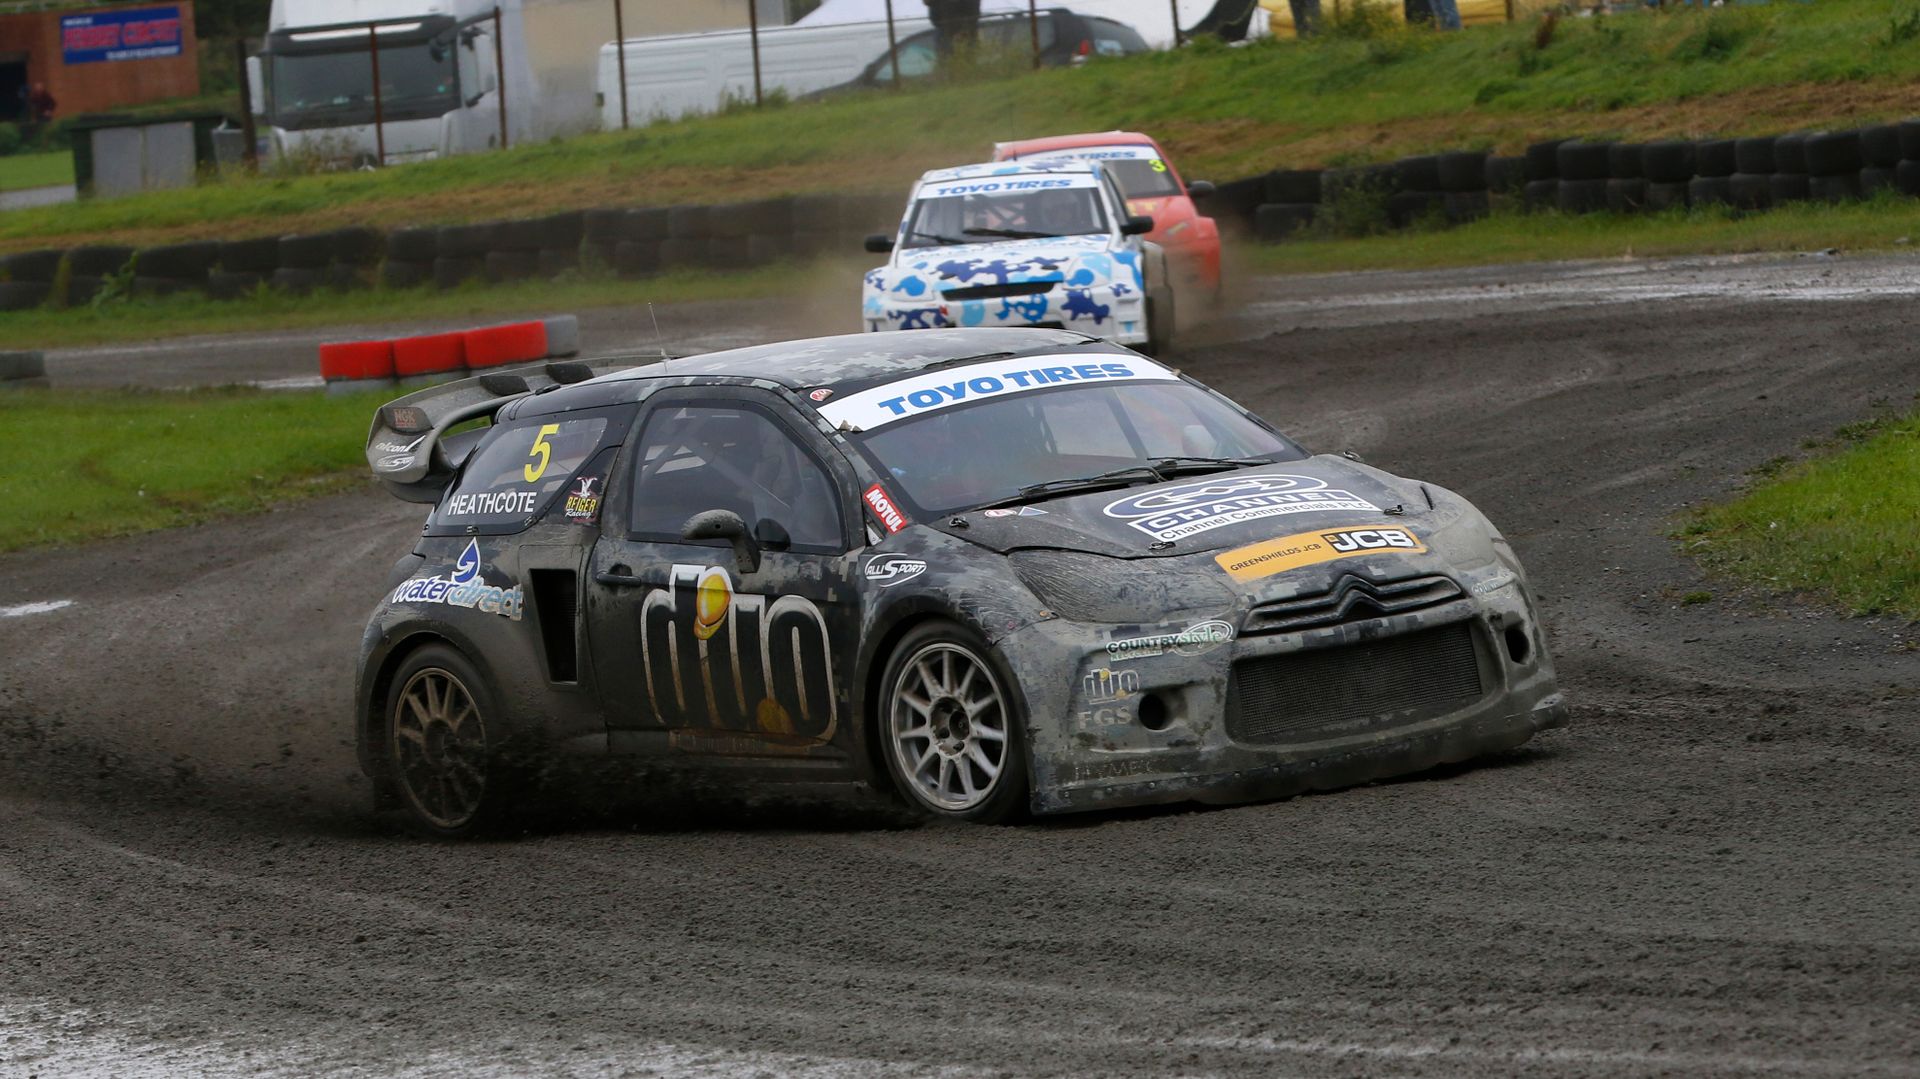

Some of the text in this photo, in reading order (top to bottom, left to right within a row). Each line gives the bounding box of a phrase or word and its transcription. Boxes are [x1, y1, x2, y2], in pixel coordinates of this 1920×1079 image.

[1149, 159, 1166, 173] 3
[937, 179, 1073, 195] TOYO TIRES
[878, 363, 1135, 415] TOYO TIRES
[524, 423, 560, 483] 5
[447, 491, 537, 515] HEATHCOTE
[565, 496, 597, 513] REIGER
[565, 509, 593, 518] Racing
[866, 488, 903, 532] MOTUL
[1148, 492, 1352, 529] CHANNEL
[1160, 501, 1374, 539] Channel Commercials PLC
[1333, 530, 1416, 551] JCB
[1230, 543, 1323, 571] GREENSHIELDS JCB
[1074, 706, 1132, 730] FGS
